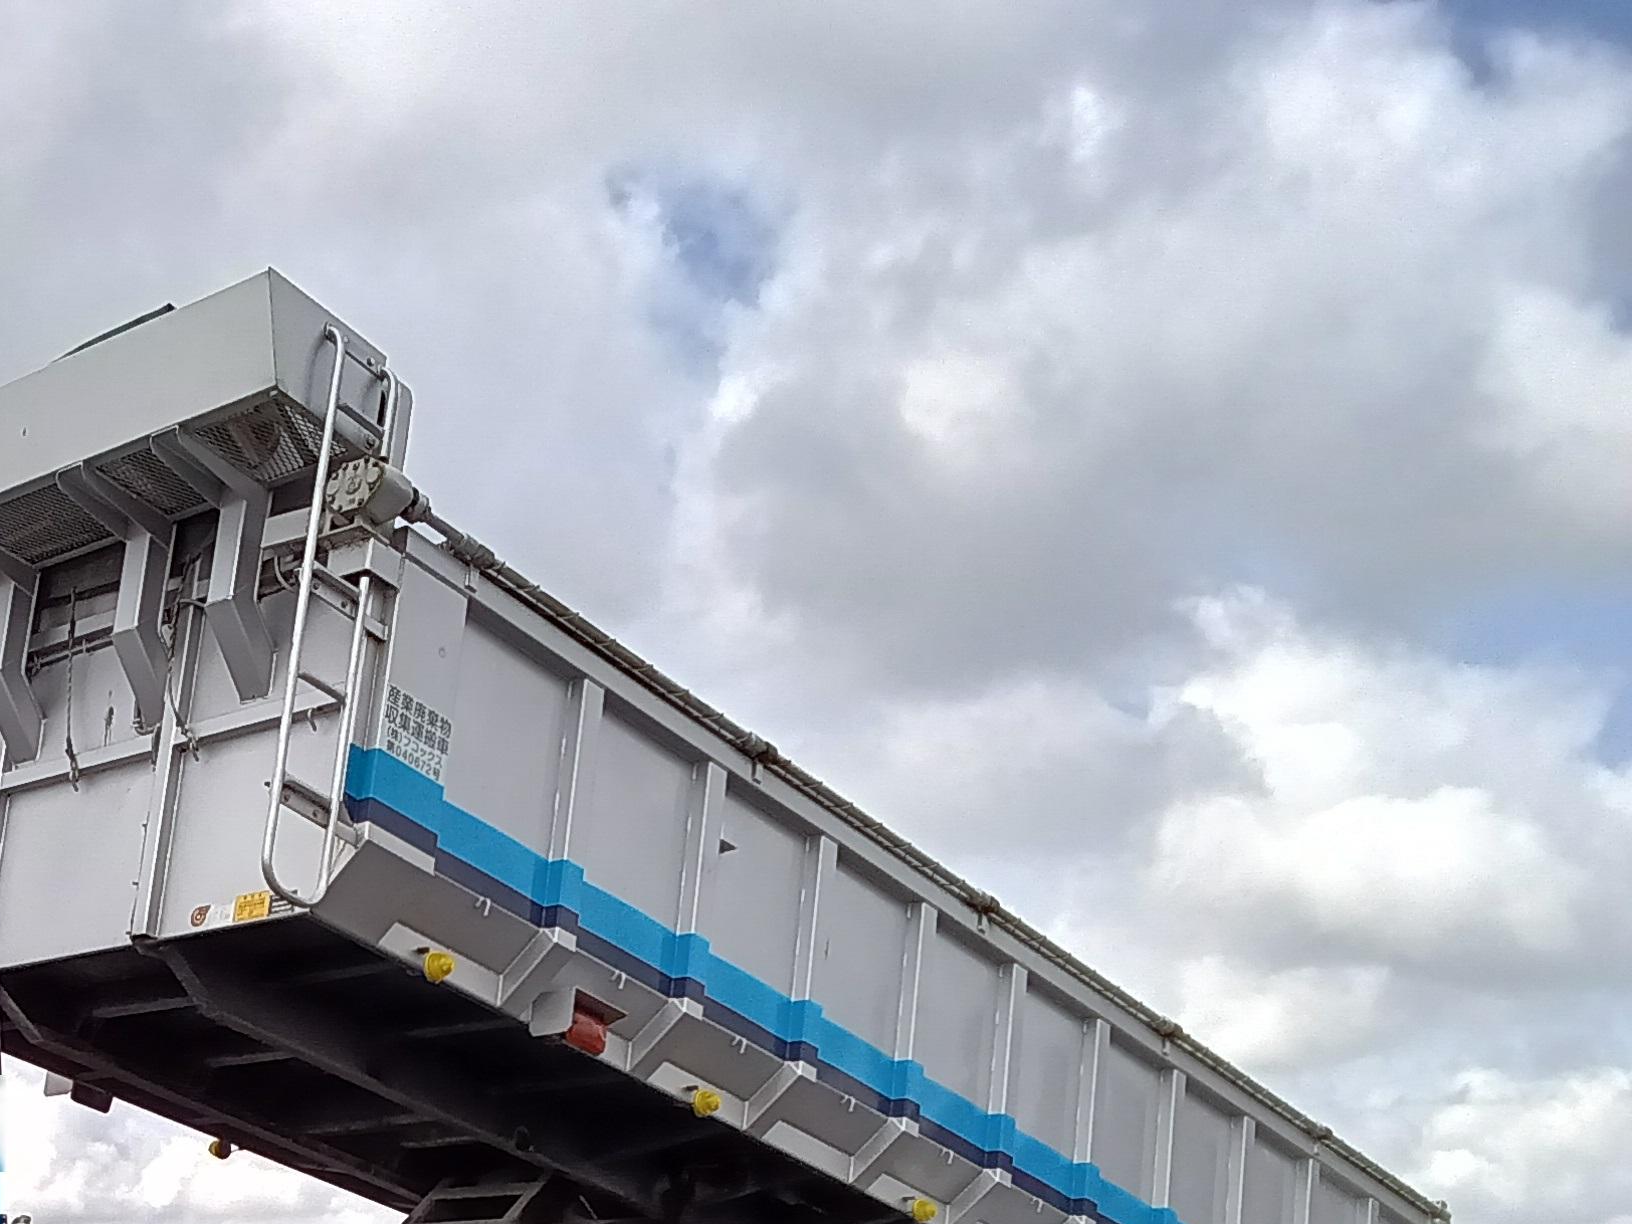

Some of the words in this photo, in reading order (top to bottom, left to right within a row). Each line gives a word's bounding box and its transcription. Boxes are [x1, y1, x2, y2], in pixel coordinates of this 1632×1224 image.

[385, 704, 448, 756] 収集運搬車
[388, 684, 451, 738] 産業廃棄物
